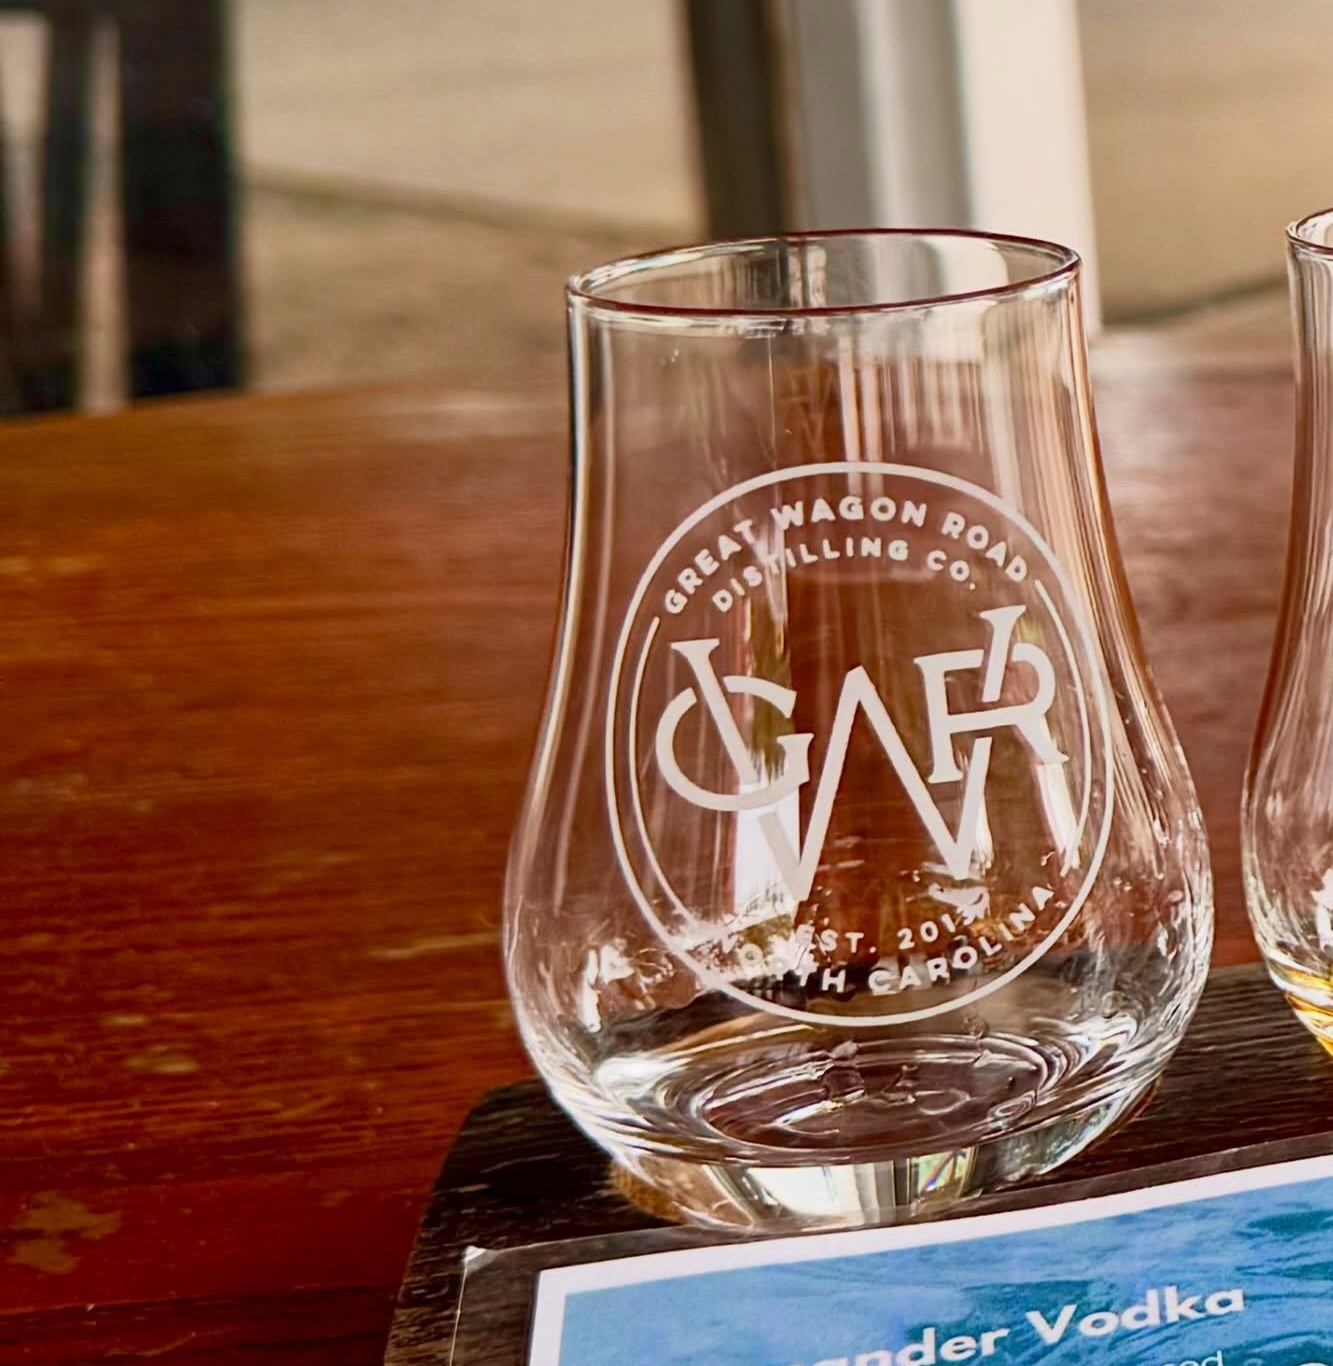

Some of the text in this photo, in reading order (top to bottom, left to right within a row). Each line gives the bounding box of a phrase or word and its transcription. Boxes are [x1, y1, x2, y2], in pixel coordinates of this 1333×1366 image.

[664, 495, 1029, 615] GREAT WAGON ROAD
[711, 536, 976, 613] DISTILLING CO.
[868, 885, 1056, 997] CAROLINA
[1025, 1283, 1245, 1345] Vodka
